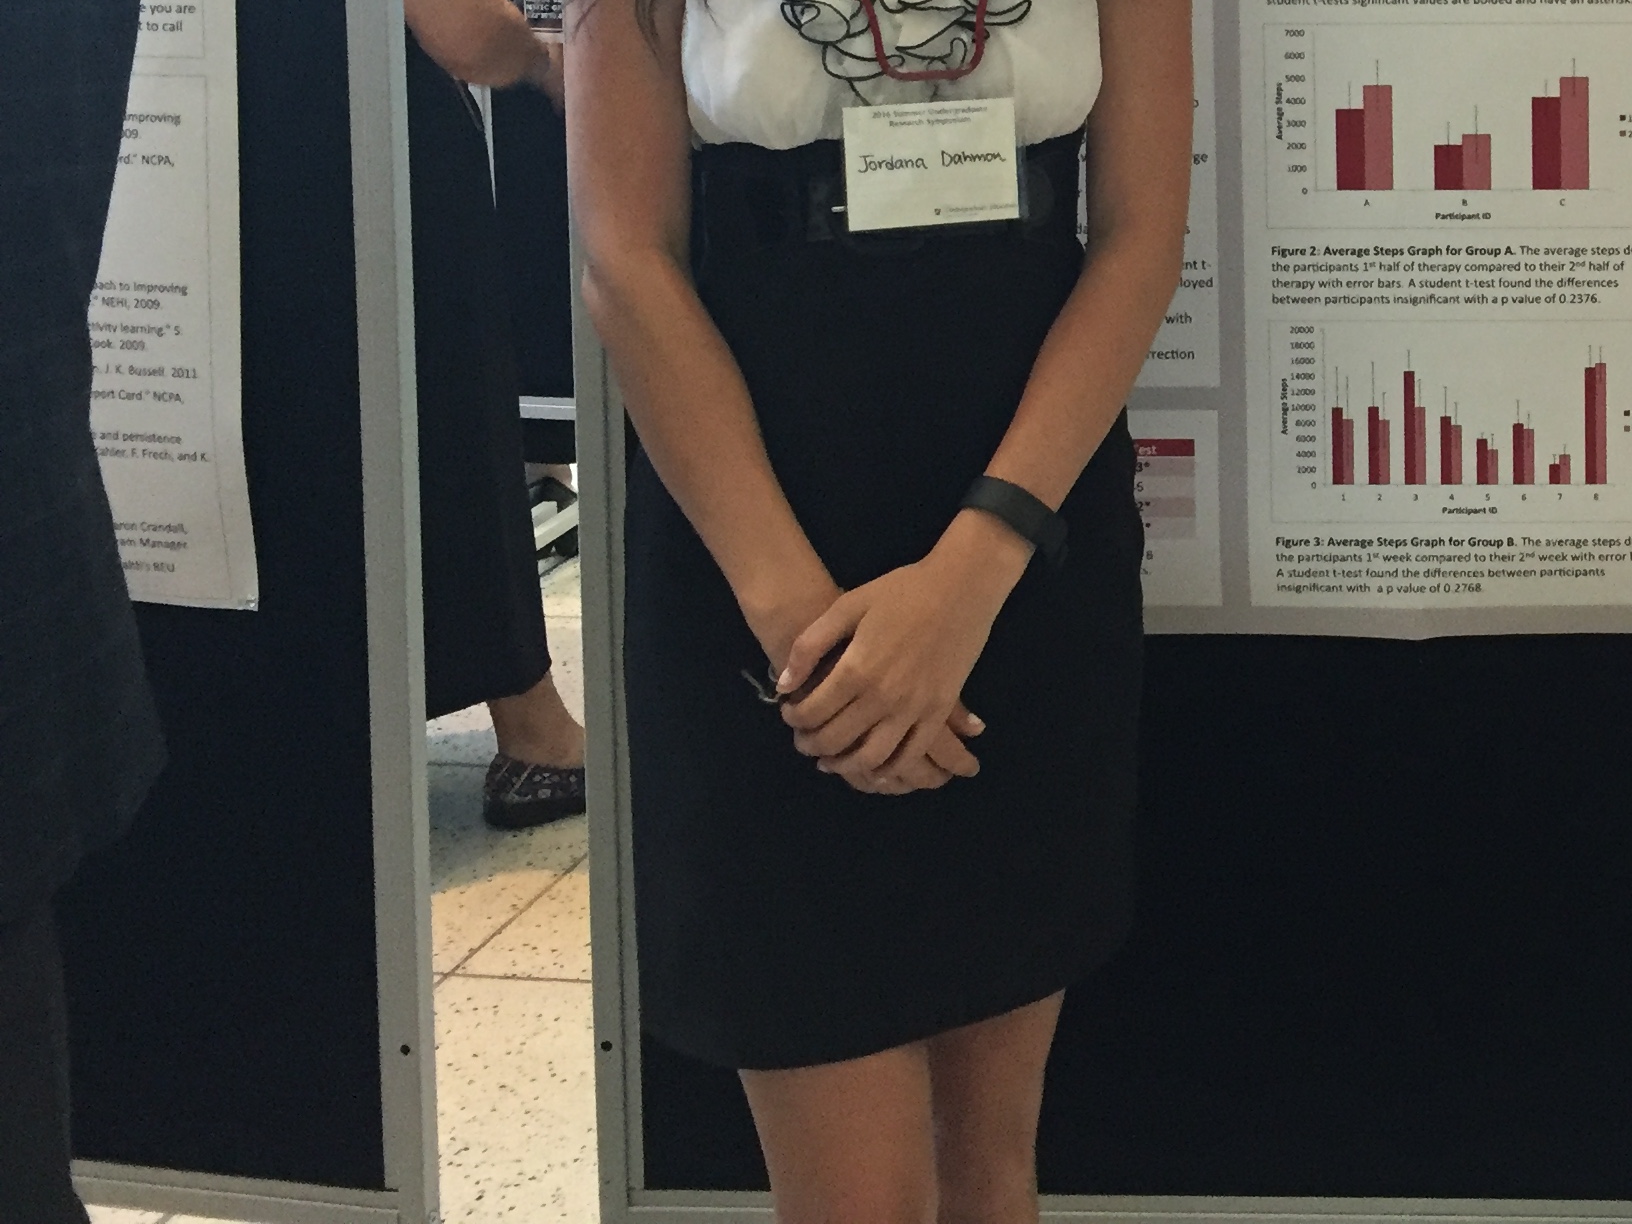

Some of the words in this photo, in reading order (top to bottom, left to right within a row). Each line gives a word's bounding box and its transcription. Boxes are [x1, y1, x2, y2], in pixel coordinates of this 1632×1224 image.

[858, 154, 928, 173] Jordana
[1164, 311, 1192, 324] with
[1275, 536, 1310, 548] Figure
[1313, 536, 1324, 546] 3:
[1327, 536, 1374, 549] Average
[1376, 536, 1407, 551] Steps
[1410, 536, 1445, 548] Graph
[1448, 536, 1465, 546] for
[1467, 536, 1504, 551] Group
